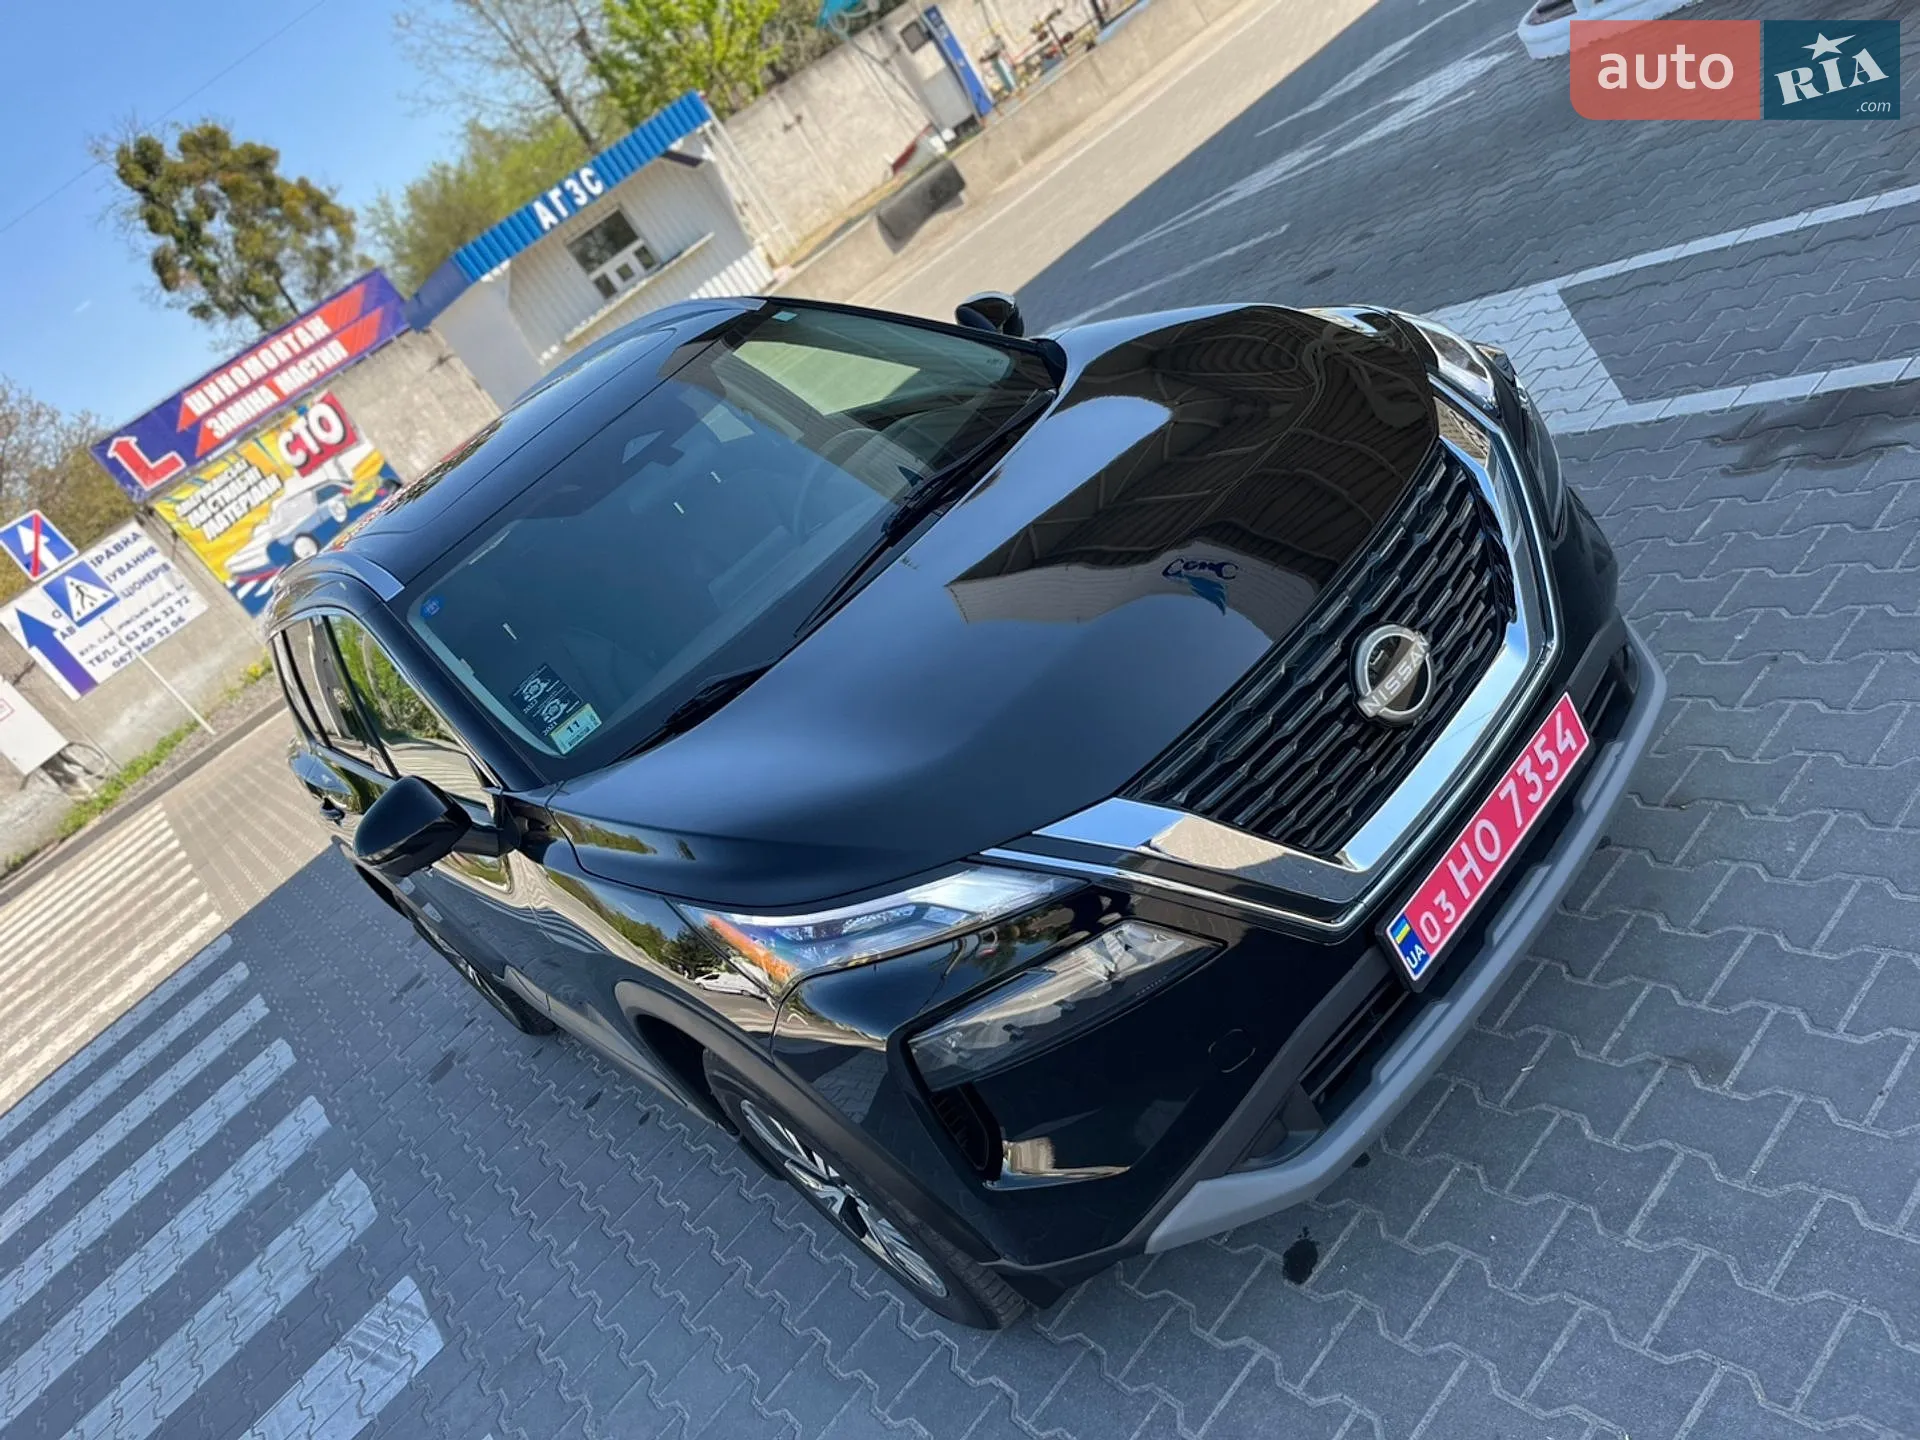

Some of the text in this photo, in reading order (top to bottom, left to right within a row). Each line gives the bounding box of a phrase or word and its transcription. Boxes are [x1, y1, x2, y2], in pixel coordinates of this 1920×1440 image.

[532, 168, 603, 230] АГЗС
[184, 315, 333, 417] ШИНОМОНТАЖ
[205, 339, 349, 439] ЗАМІНА МАСТИЛ
[278, 403, 346, 467] СТО
[1363, 631, 1429, 714] NISSAN
[1419, 889, 1456, 944] 03
[1499, 711, 1578, 828] 7354
[1407, 946, 1426, 969] UA
